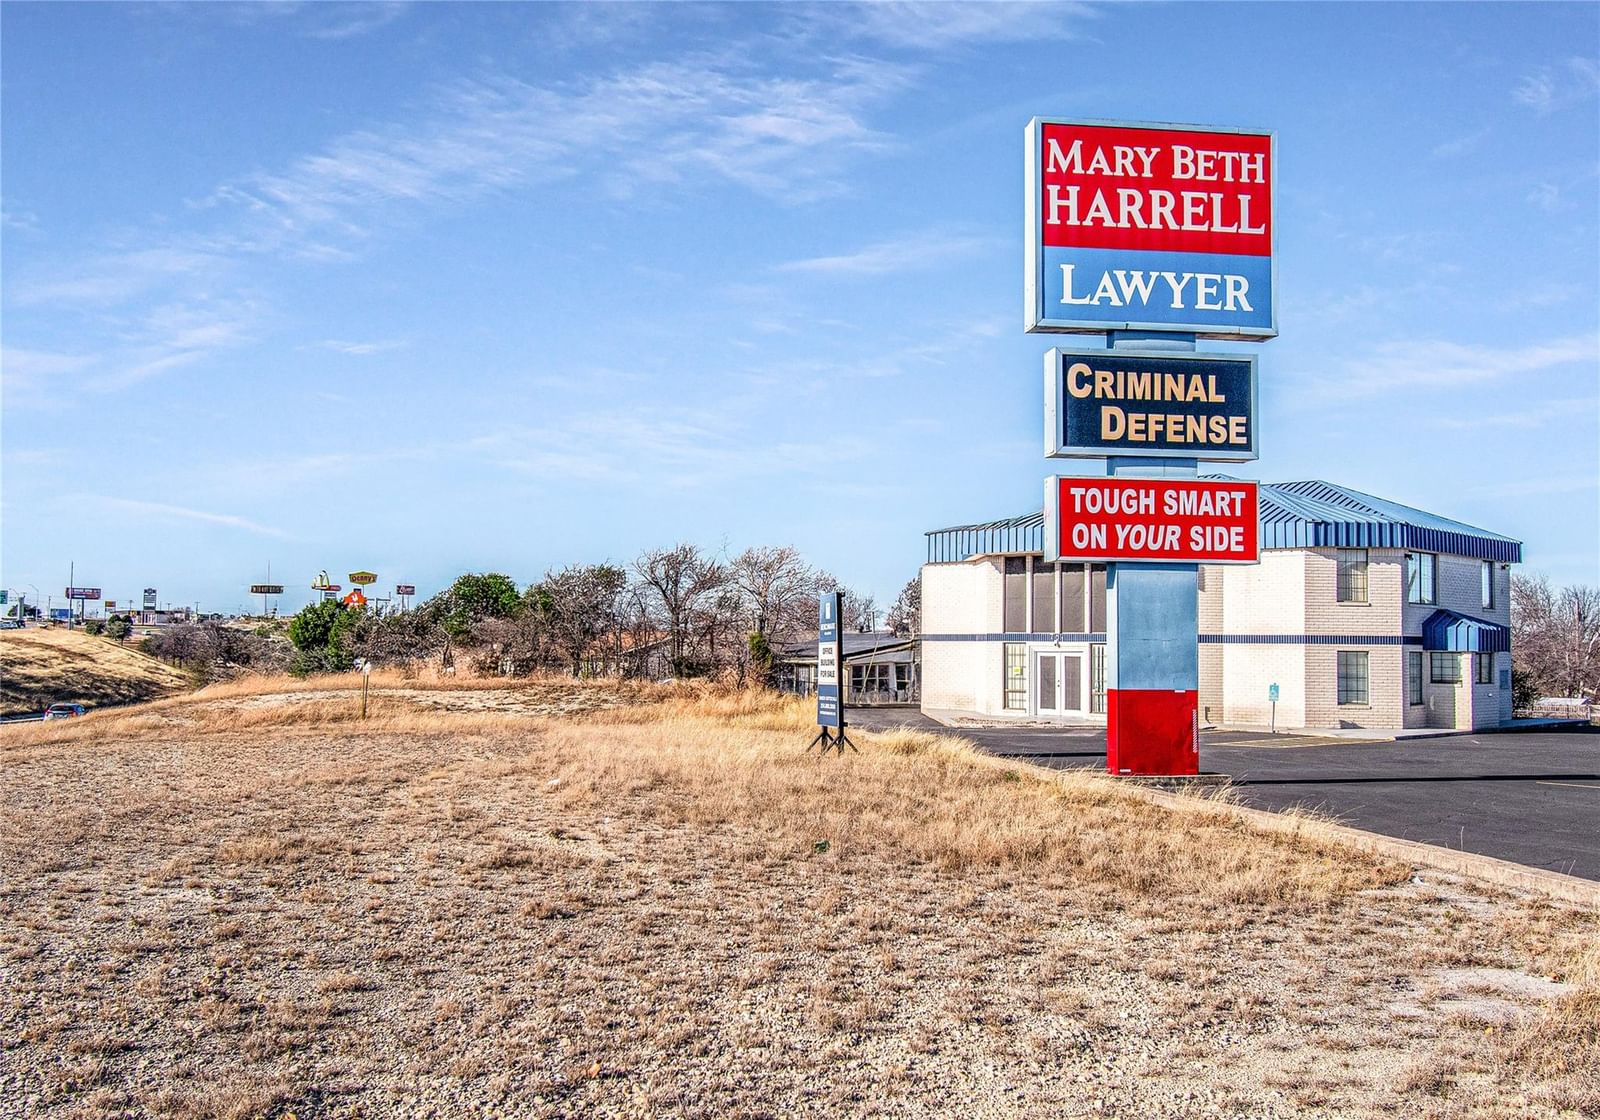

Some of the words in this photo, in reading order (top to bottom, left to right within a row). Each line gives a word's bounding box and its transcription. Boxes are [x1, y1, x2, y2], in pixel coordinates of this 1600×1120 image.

[1047, 138, 1161, 178] MARY
[1171, 145, 1265, 184] BETH
[1047, 185, 1266, 235] HARRELL
[1060, 264, 1253, 312] LAWYER
[1067, 363, 1226, 403] CRIMINAL
[1101, 406, 1248, 444] DEFENSE
[1070, 487, 1155, 515] TOUGH
[1164, 489, 1246, 517] SMART
[1072, 523, 1107, 549] ON
[1115, 524, 1181, 550] YOUR
[1190, 525, 1244, 552] SIDE
